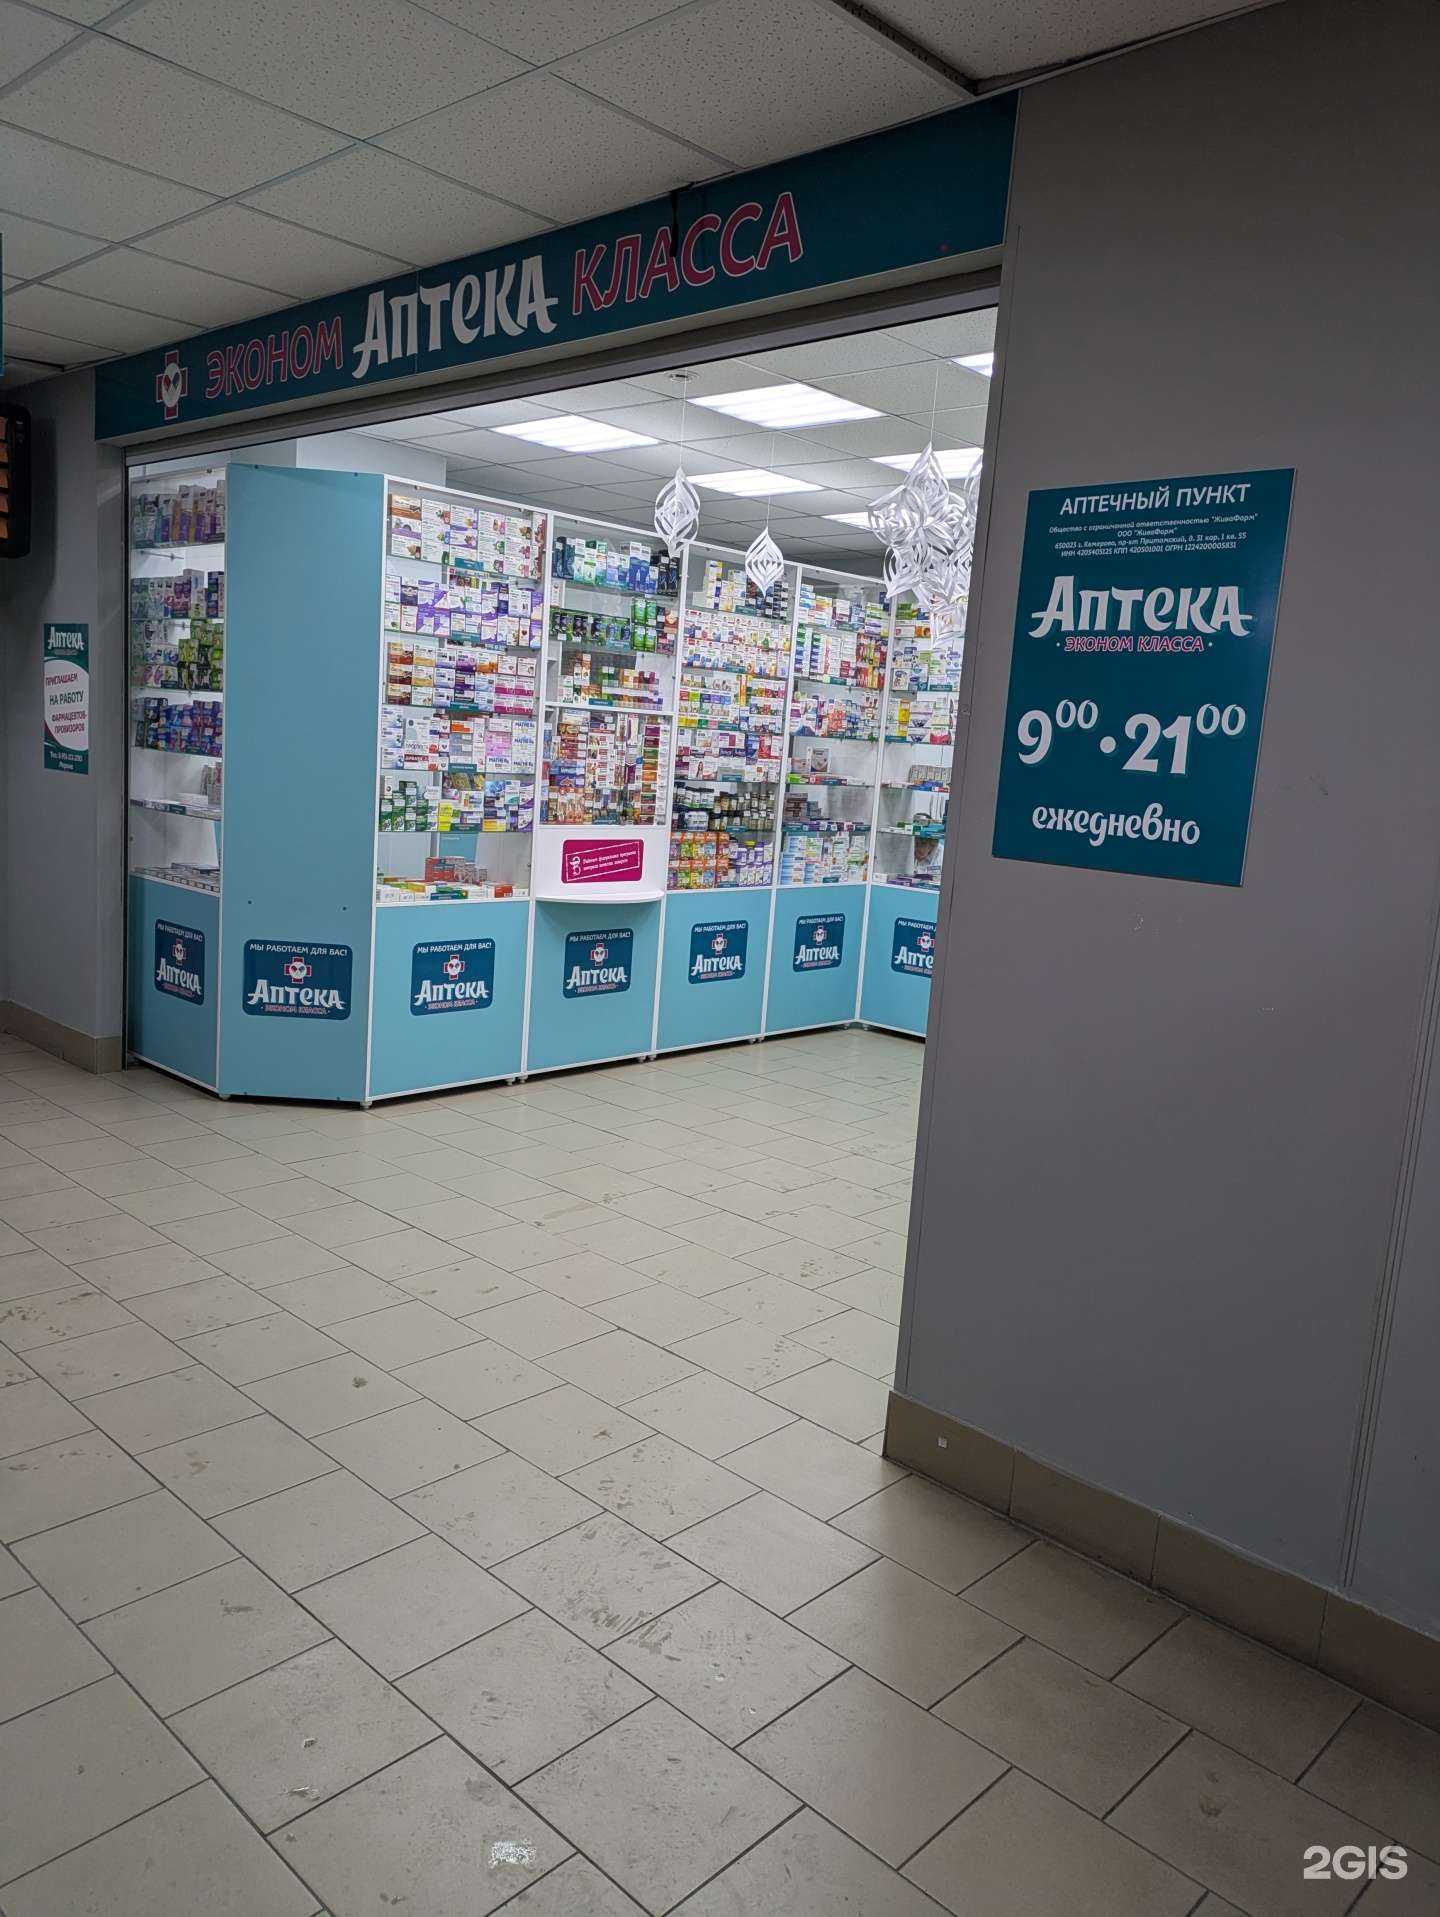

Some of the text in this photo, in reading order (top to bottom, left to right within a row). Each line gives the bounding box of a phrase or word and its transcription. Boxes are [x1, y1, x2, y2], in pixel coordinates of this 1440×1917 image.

[204, 316, 344, 400] ЭКОНОМ
[570, 191, 803, 317] КЛАССА
[1059, 483, 1252, 515] АПТЕЧНЫЙ ПУНКТ
[1136, 518, 1210, 528] ответственностью
[1165, 544, 1183, 552] ОГРН
[1064, 636, 1205, 652] ЭКОНОМ КЛАССА
[49, 690, 84, 705] НА РАБОТУ
[1032, 802, 1201, 847] ежедневно
[907, 921, 934, 930] РАБОТАЕМ
[579, 933, 607, 941] РАБОТАЕМ
[249, 943, 348, 956] МЫ РАБОТАЕМ ДЛЯ ВАС!
[416, 942, 492, 954] МЫ РАБОТАЕМ ДЛЯ ВАС!
[894, 946, 934, 969] Апте
